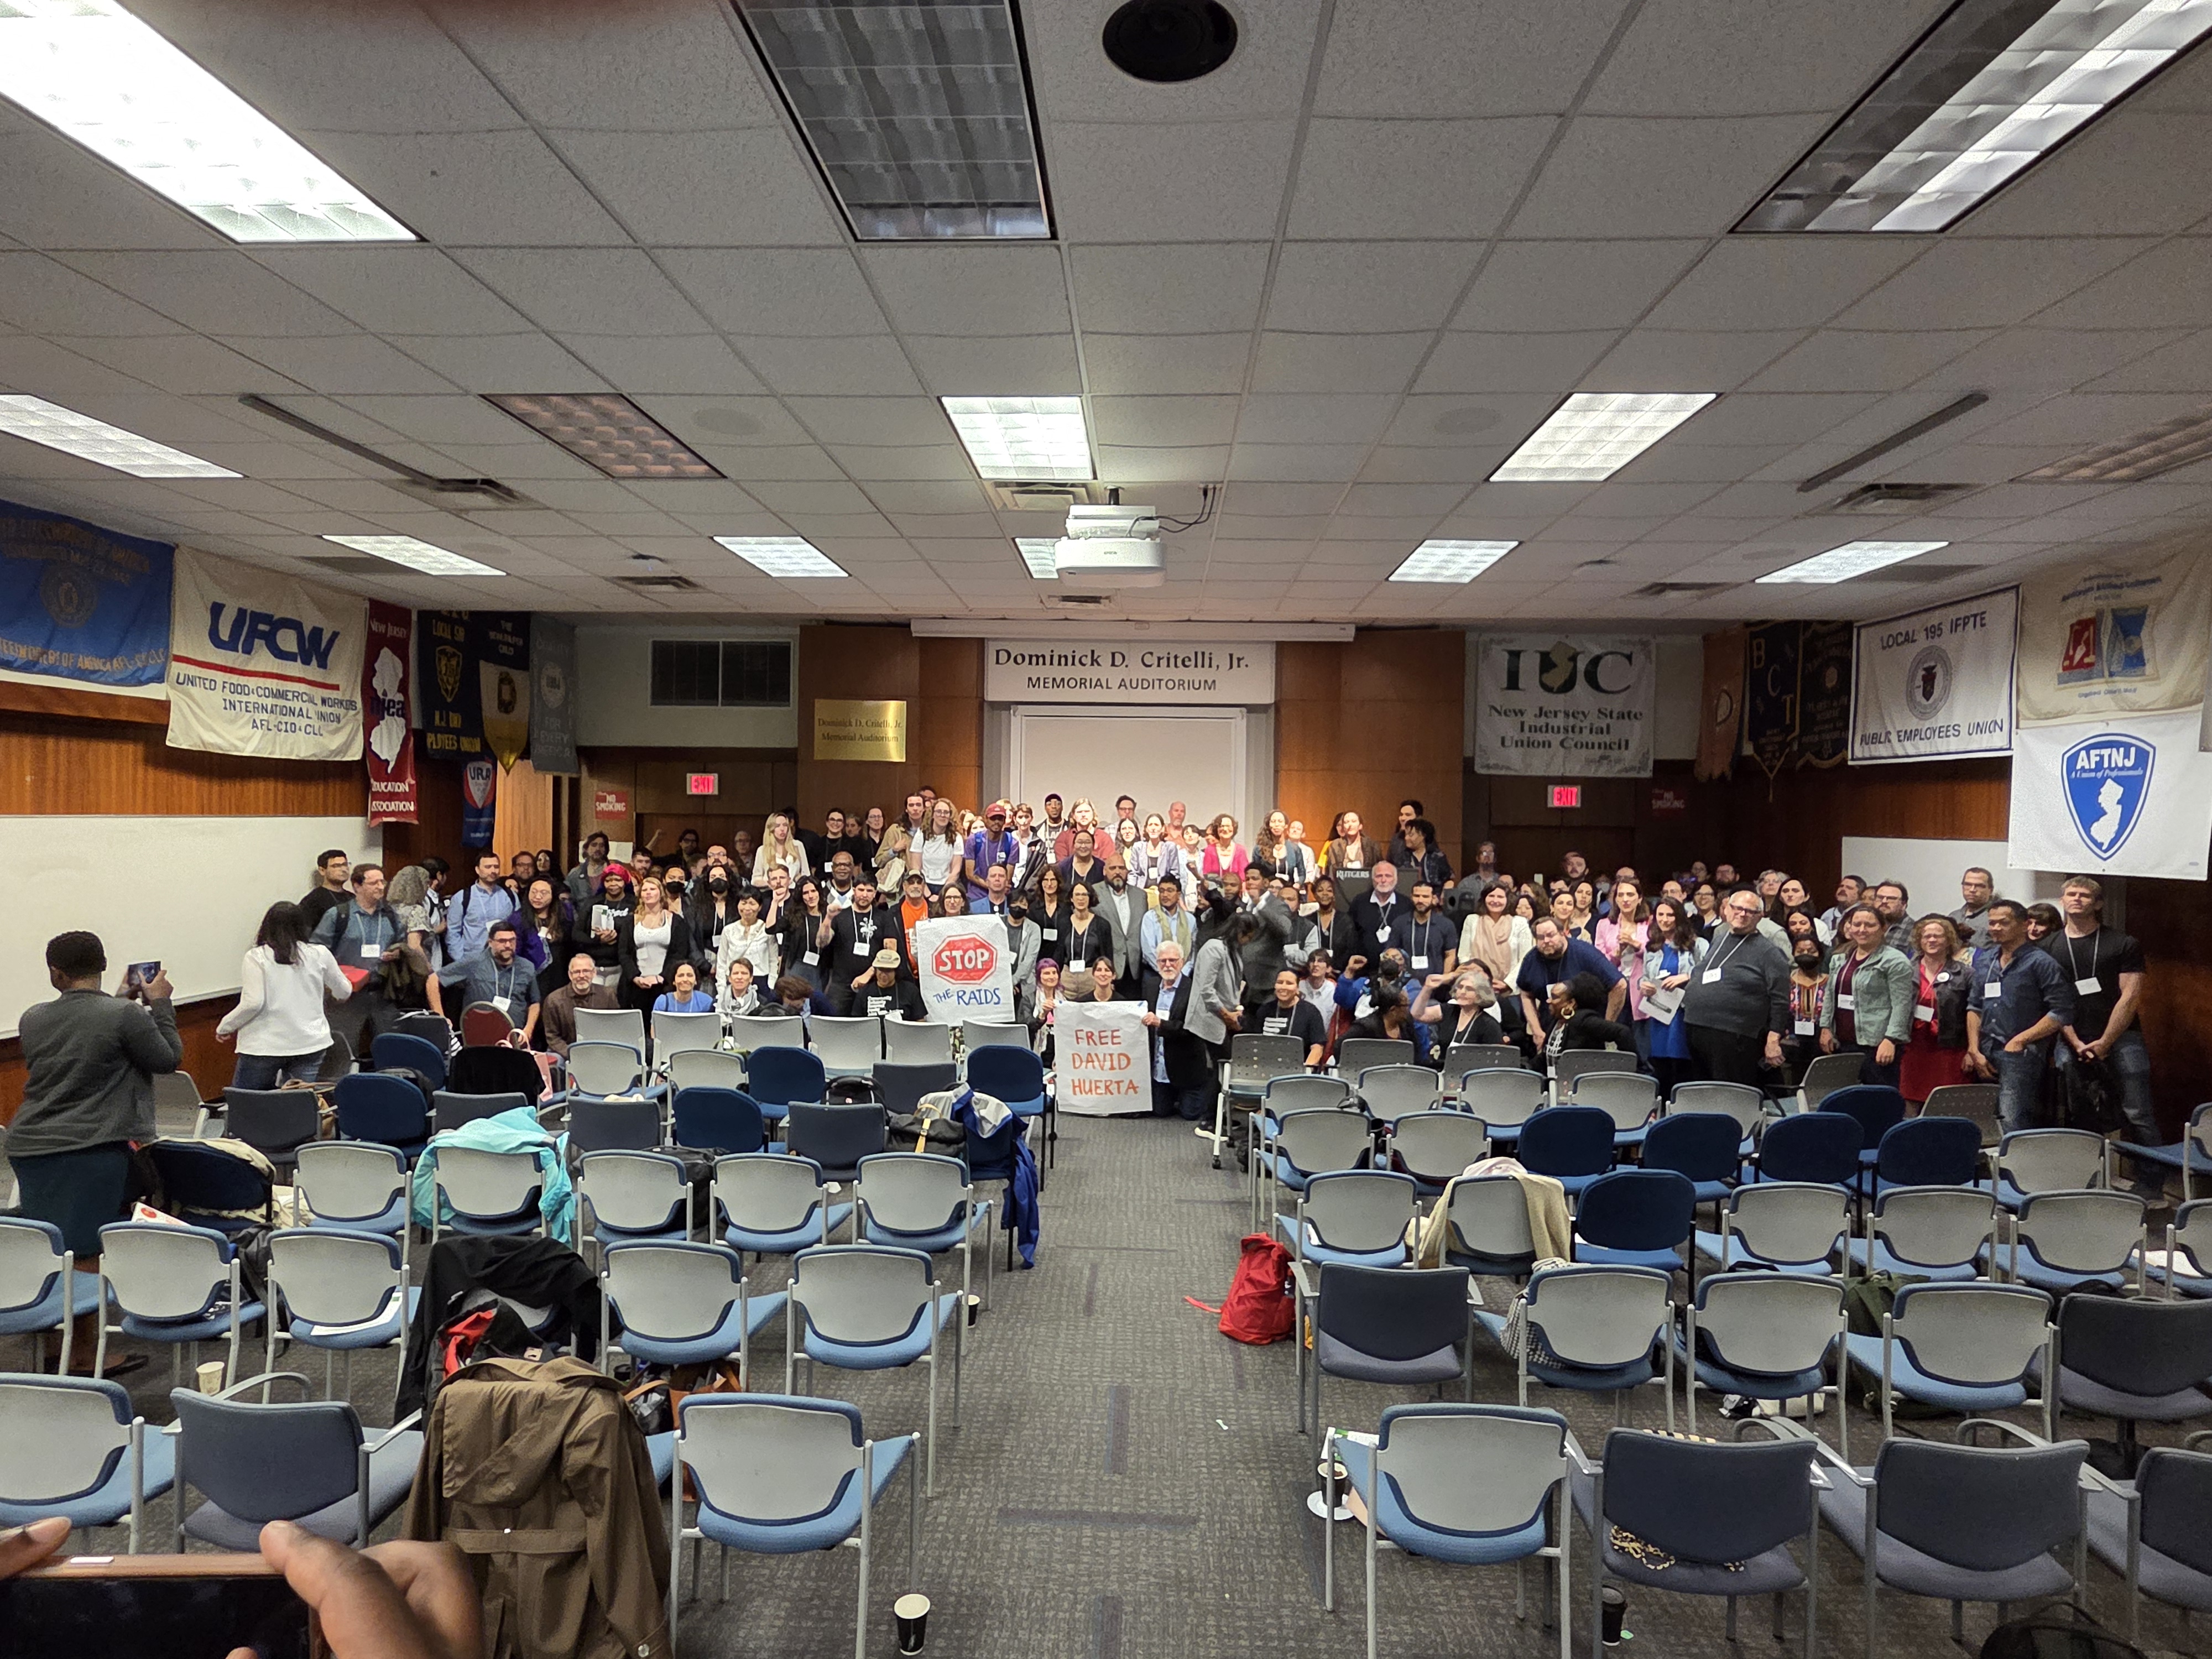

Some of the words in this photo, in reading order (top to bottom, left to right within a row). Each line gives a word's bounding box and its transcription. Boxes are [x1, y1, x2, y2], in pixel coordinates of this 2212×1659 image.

[208, 601, 341, 669] UFCW
[1881, 629, 1917, 650] LOCAL
[1924, 623, 1943, 640] 195
[1950, 611, 1987, 634] IFPTE
[995, 649, 1102, 666] Dominick
[1110, 651, 1129, 668] D.
[1141, 651, 1220, 671] Critelli,
[1228, 653, 1249, 671] Jr.
[1500, 649, 1633, 694] IUC
[176, 672, 217, 691] UNITED
[222, 681, 250, 696] FOOD
[1027, 677, 1112, 690] MEMORIAL
[1118, 678, 1216, 691] AUDITORIUM
[222, 698, 312, 719] INTERNATIONAL
[1488, 705, 1526, 718] New
[1534, 706, 1590, 723] Jersey
[1598, 707, 1643, 720] State
[818, 718, 852, 727] Dominick
[1520, 720, 1610, 735] Industrial
[822, 733, 856, 742] Memorial
[858, 734, 899, 742] Auditorium
[1897, 724, 1961, 742] EMPLOYEES
[1500, 736, 1552, 748] Union
[1559, 737, 1629, 750] Council
[2076, 747, 2136, 770] AFTNJ
[469, 766, 491, 780] URA
[692, 776, 714, 792] EXIT
[1554, 787, 1577, 806] EXIT
[596, 802, 626, 812] SMOKING
[1336, 870, 1369, 880] RUTGERS
[940, 948, 990, 972] STOP
[933, 988, 954, 1003] THE
[956, 988, 1001, 1006] RAIDS
[1075, 1029, 1122, 1046] FREE
[1072, 1052, 1131, 1071] DAVID
[1071, 1078, 1140, 1096] HUERTA
